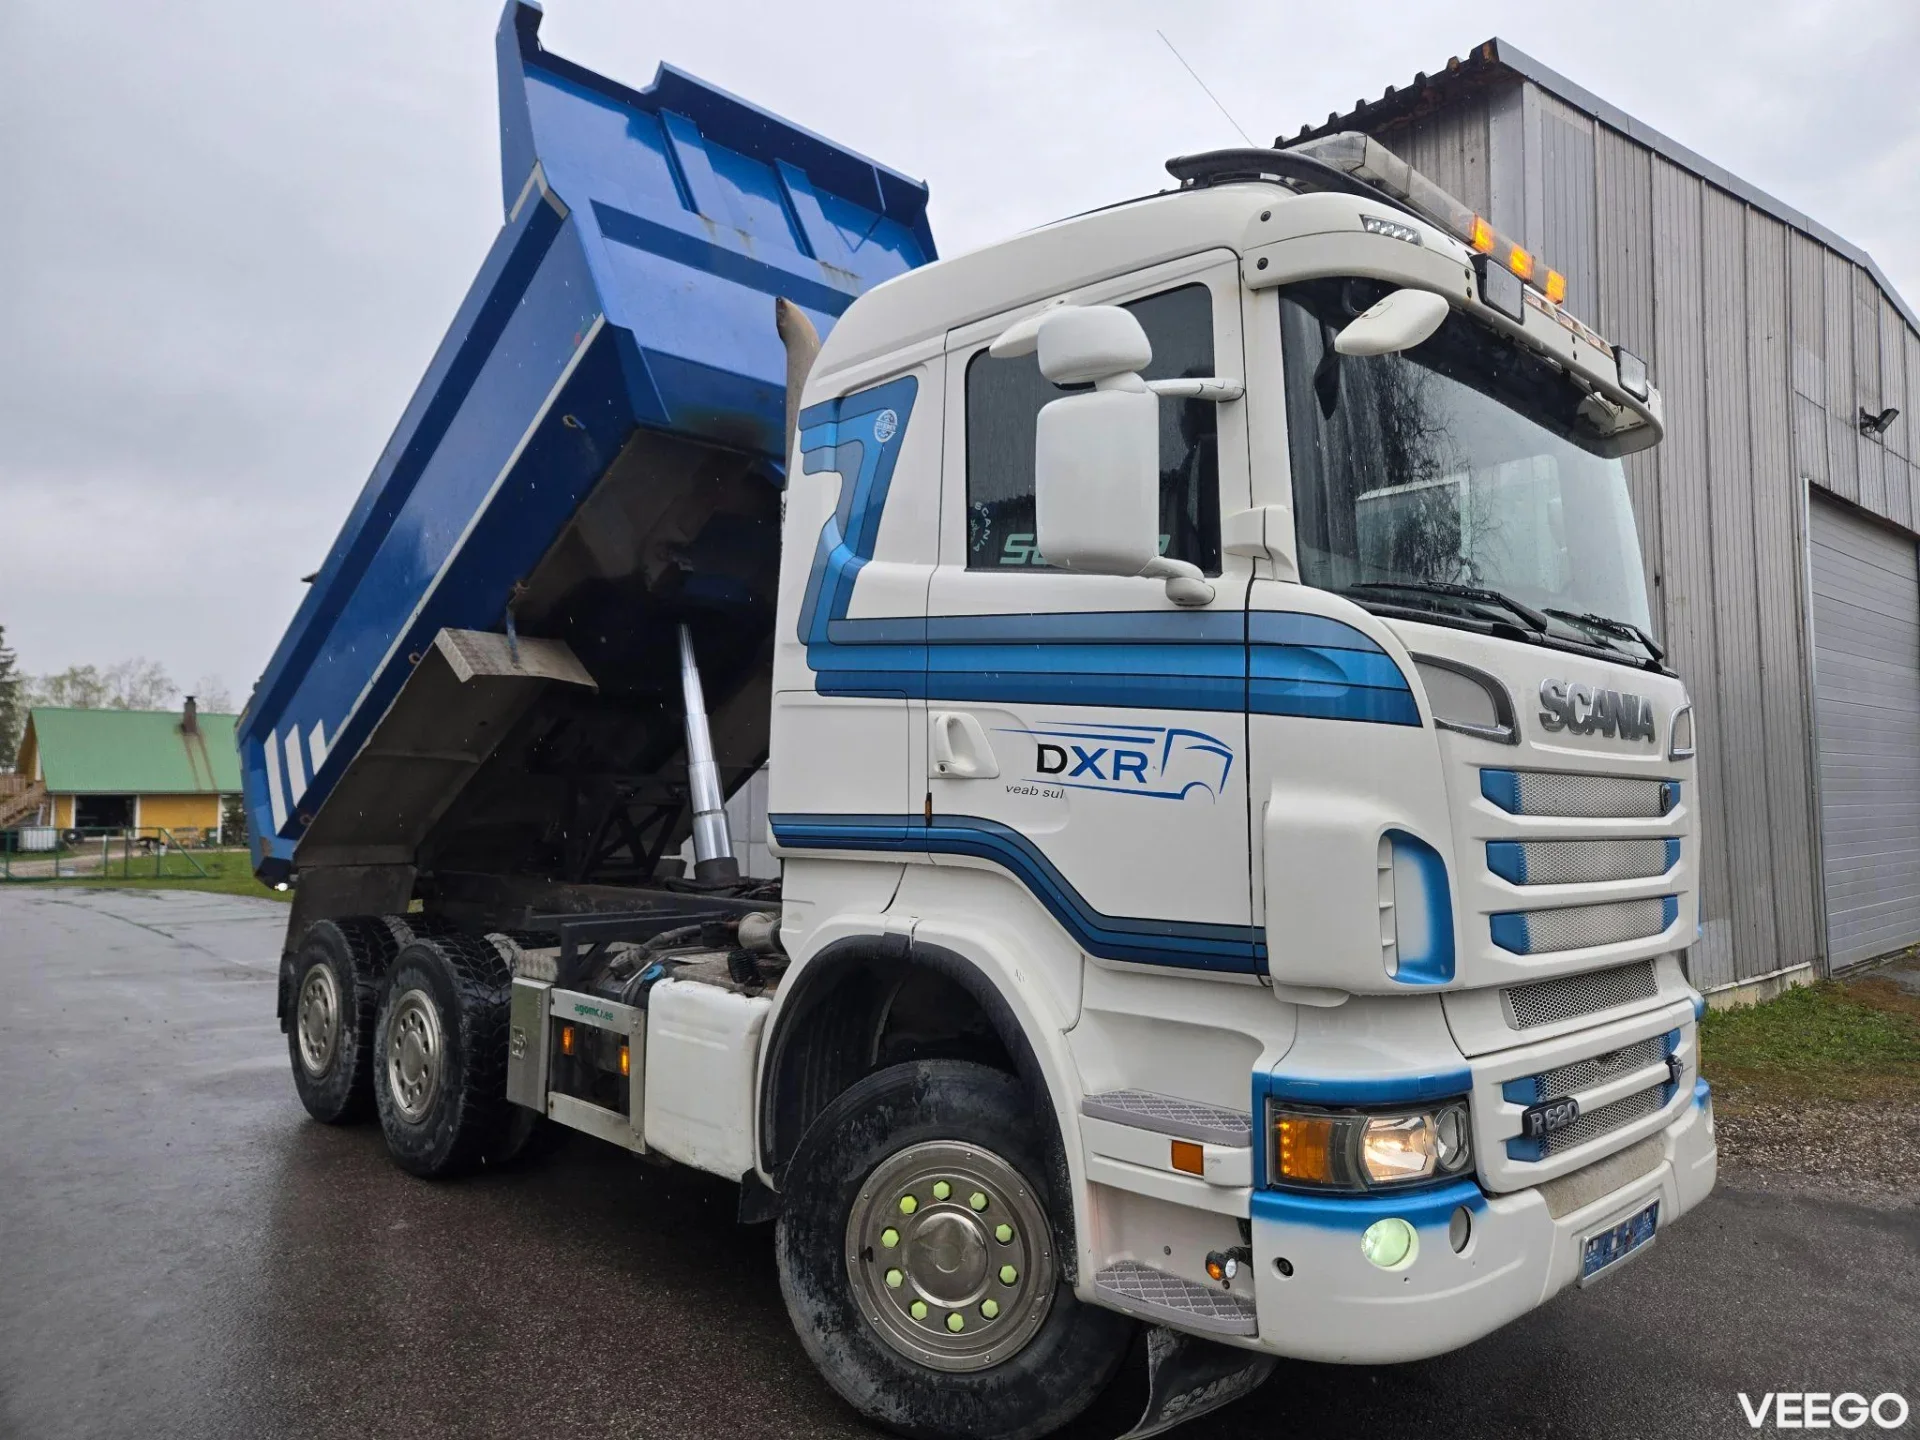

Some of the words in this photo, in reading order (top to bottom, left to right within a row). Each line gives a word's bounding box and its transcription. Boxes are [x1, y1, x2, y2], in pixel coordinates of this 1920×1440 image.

[973, 501, 991, 552] SCANIA
[1539, 678, 1656, 743] SCANIA
[1037, 743, 1147, 783] DXR
[1006, 784, 1039, 796] veab
[1042, 788, 1065, 799] sul
